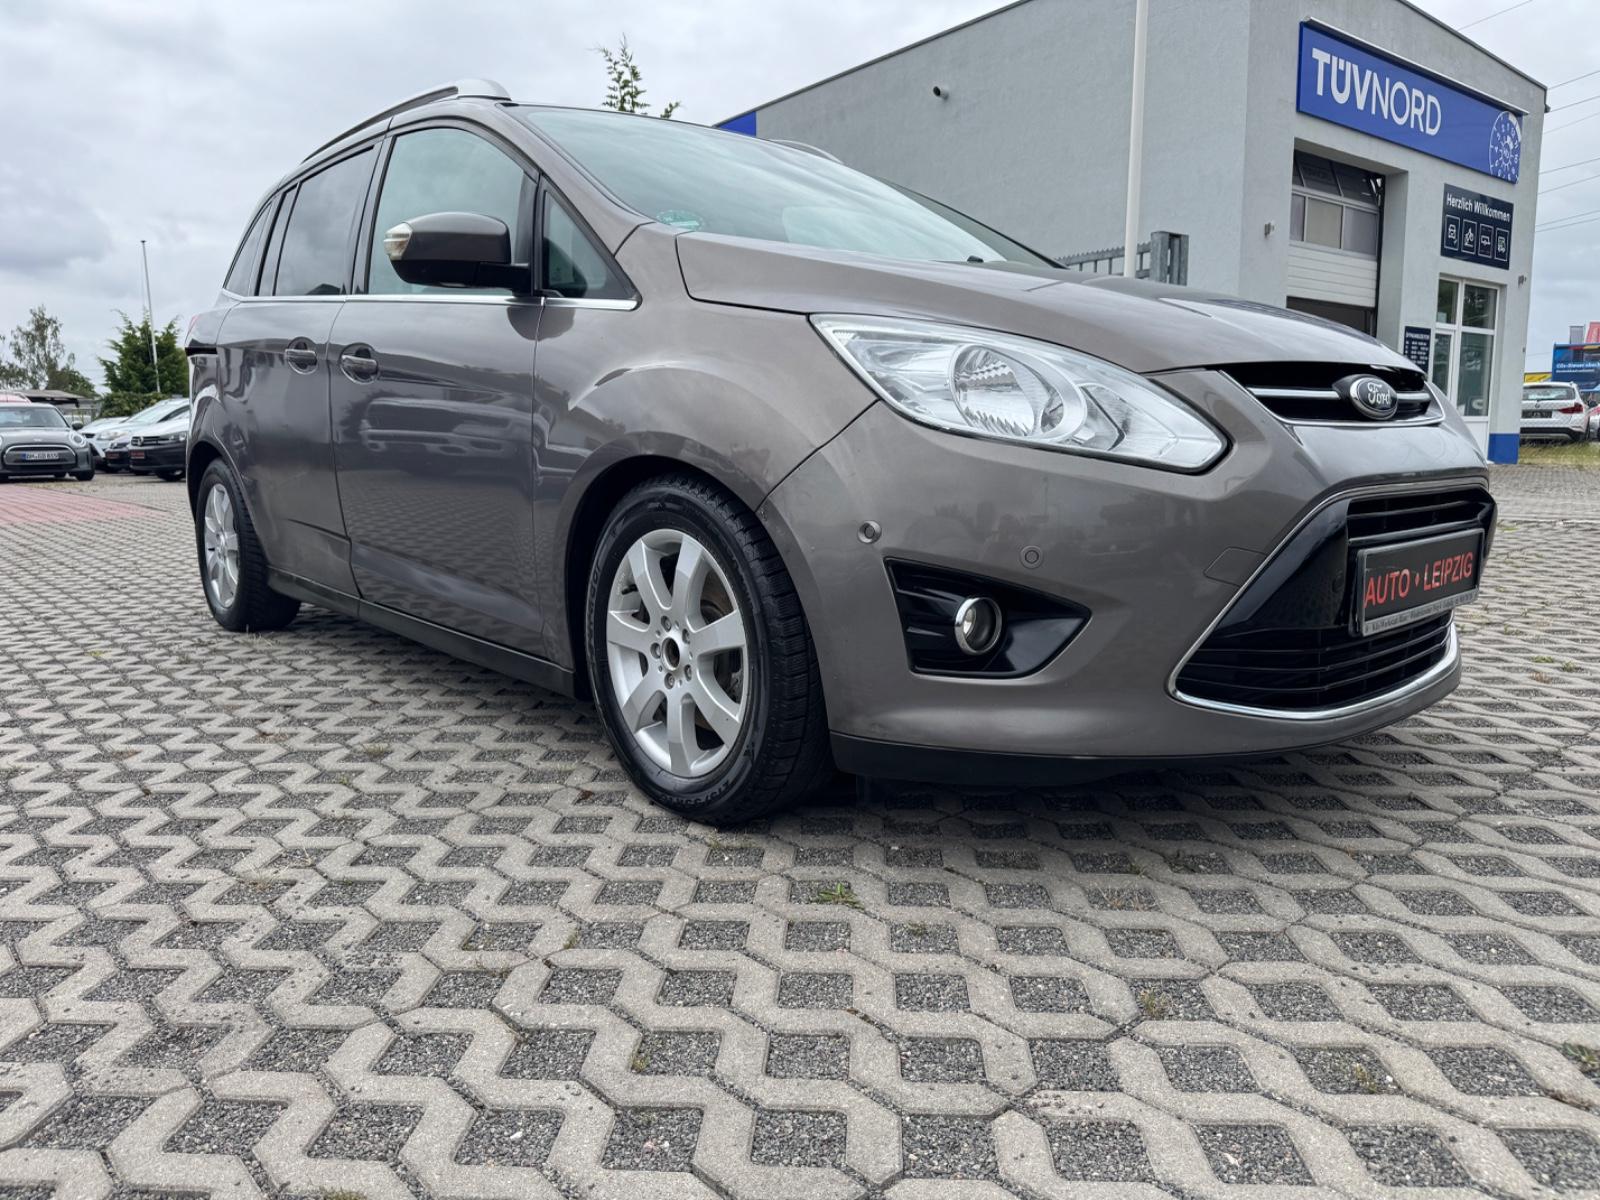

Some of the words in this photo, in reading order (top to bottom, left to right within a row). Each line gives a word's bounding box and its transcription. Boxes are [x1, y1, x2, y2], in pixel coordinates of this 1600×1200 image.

[1446, 193, 1473, 212] Herzlich
[1474, 200, 1511, 222] Willkommen
[1367, 382, 1391, 405] Ford
[1362, 568, 1411, 609] AUTO
[1423, 551, 1473, 591] LEIPZIG
